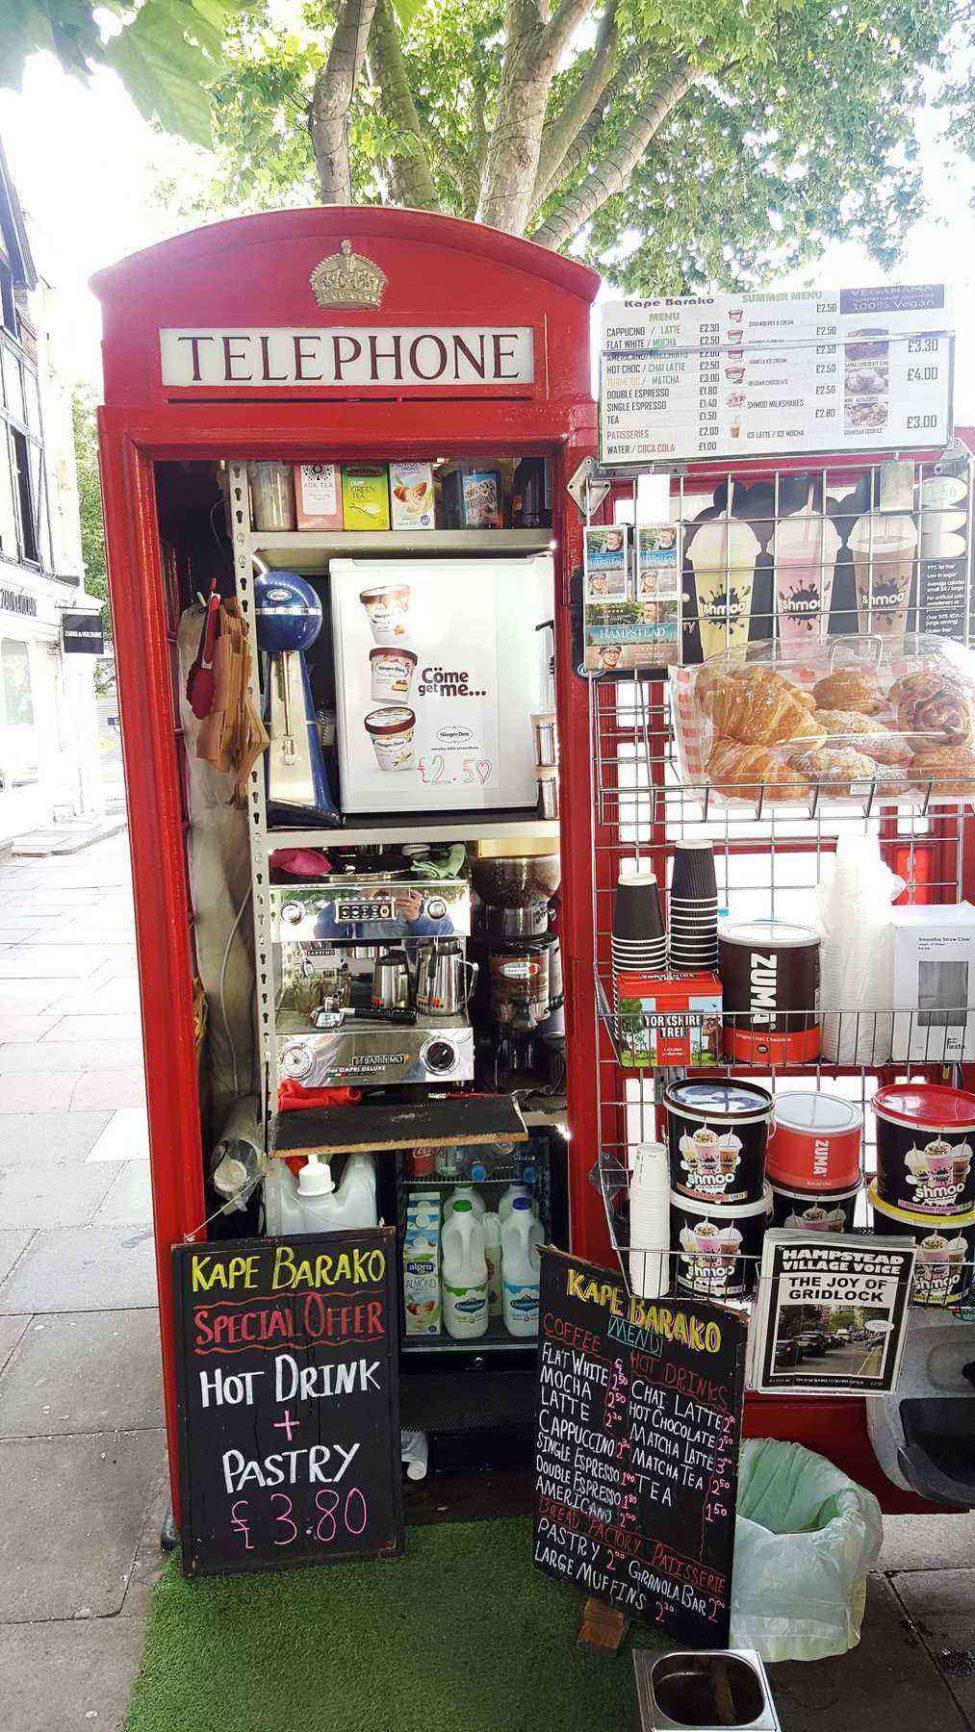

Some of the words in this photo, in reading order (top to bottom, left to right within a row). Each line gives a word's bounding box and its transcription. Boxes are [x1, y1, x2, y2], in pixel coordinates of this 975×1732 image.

[665, 297, 715, 307] Barako
[742, 294, 788, 303] SUMMER
[790, 291, 823, 301] MENU
[649, 312, 680, 322] MENU
[660, 324, 682, 335] LATTE
[699, 323, 720, 333] £2.30
[606, 340, 623, 349] FLAT
[624, 339, 645, 348] WHITE
[652, 338, 677, 347] MOCHA
[699, 336, 720, 346] £2.50
[816, 344, 837, 354] £2.50
[908, 339, 939, 353] £3.30
[178, 333, 520, 382] TELEPHONE
[606, 365, 620, 374] HOT
[621, 364, 641, 374] CHOC
[648, 364, 665, 373] CHAI
[666, 362, 686, 372] LATTE
[699, 361, 720, 371] £2.50
[816, 364, 837, 374] £2.50
[907, 367, 938, 381] £4.00
[652, 375, 680, 385] MATCHA
[699, 373, 720, 383] £3.00
[606, 390, 632, 400] DOUBLE
[634, 388, 670, 399] ESPRESSO
[816, 385, 837, 395] £2.50
[606, 402, 630, 412] SINGLE
[632, 400, 667, 411] ESPRESSO
[769, 399, 805, 409] MILKSHAKES
[607, 415, 620, 425] TEA
[699, 411, 718, 421] £1.50
[906, 415, 938, 429] £3.00
[607, 429, 649, 440] PATISSERIES
[699, 426, 719, 437] £2.00
[606, 445, 631, 455] WATER
[637, 443, 656, 453] COCA
[657, 442, 676, 453] COLA
[862, 592, 904, 607] shmoo
[600, 628, 666, 640] HAMPSTEAD
[421, 667, 469, 684] Cöme
[418, 683, 438, 697] get
[440, 683, 487, 697] me...
[750, 952, 777, 1025] ZUMA
[813, 1139, 829, 1175] ZUMA
[687, 1172, 735, 1186] shmoo
[915, 1182, 965, 1199] shmoo
[782, 1249, 904, 1265] HAMPSTEAD
[191, 1254, 261, 1293] KAPE
[272, 1246, 386, 1290] BARAKO
[408, 1262, 432, 1272] alpra
[686, 1264, 736, 1280] shmoo
[782, 1260, 849, 1272] VILLAGE
[853, 1262, 901, 1275] VOICE
[406, 1278, 436, 1288] ALMOND
[789, 1276, 822, 1288] THE
[826, 1277, 860, 1289] JOY
[864, 1279, 888, 1290] OF
[788, 1289, 884, 1303] GRIDLOCK
[193, 1304, 296, 1345] SPECIAL
[304, 1292, 386, 1338] OFFER
[566, 1268, 624, 1317] KAPE
[628, 1296, 722, 1354] BARAKO
[543, 1312, 601, 1352] COFFEE
[608, 1316, 663, 1356] MENU
[542, 1341, 570, 1369] FLAT
[571, 1349, 609, 1387] WHITE
[200, 1368, 266, 1408] HOT
[274, 1353, 382, 1402] DRINK
[540, 1364, 592, 1401] MOCHA
[630, 1350, 655, 1375] HOT
[664, 1362, 728, 1404] DRINKS
[541, 1385, 590, 1422] LATTE
[631, 1379, 667, 1411] CHAI
[674, 1394, 723, 1431] LATTE
[629, 1400, 652, 1423] HOT
[651, 1408, 716, 1449] CHOCOLATE
[539, 1409, 615, 1457] CAPPUCCINO
[630, 1422, 680, 1460] MATCHA
[684, 1441, 715, 1472] LATTE
[536, 1431, 571, 1462] SINGLE
[573, 1446, 620, 1483] ESPRESSO
[221, 1442, 361, 1495] PASTRY
[631, 1447, 679, 1481] MATCHA
[680, 1463, 704, 1491] TEA
[536, 1454, 571, 1485] DOUBLE
[573, 1470, 622, 1507] ESPRESSO
[635, 1473, 673, 1508] TEA
[535, 1475, 612, 1524] AMERICANO
[588, 1517, 644, 1555] FACTORY
[651, 1541, 727, 1596] PATISSERIE
[537, 1516, 601, 1561] PASTRY
[628, 1559, 680, 1602] GRANOLA
[681, 1584, 707, 1617] BAR
[534, 1540, 574, 1576] LARGE
[575, 1561, 648, 1611] MUFFINS
